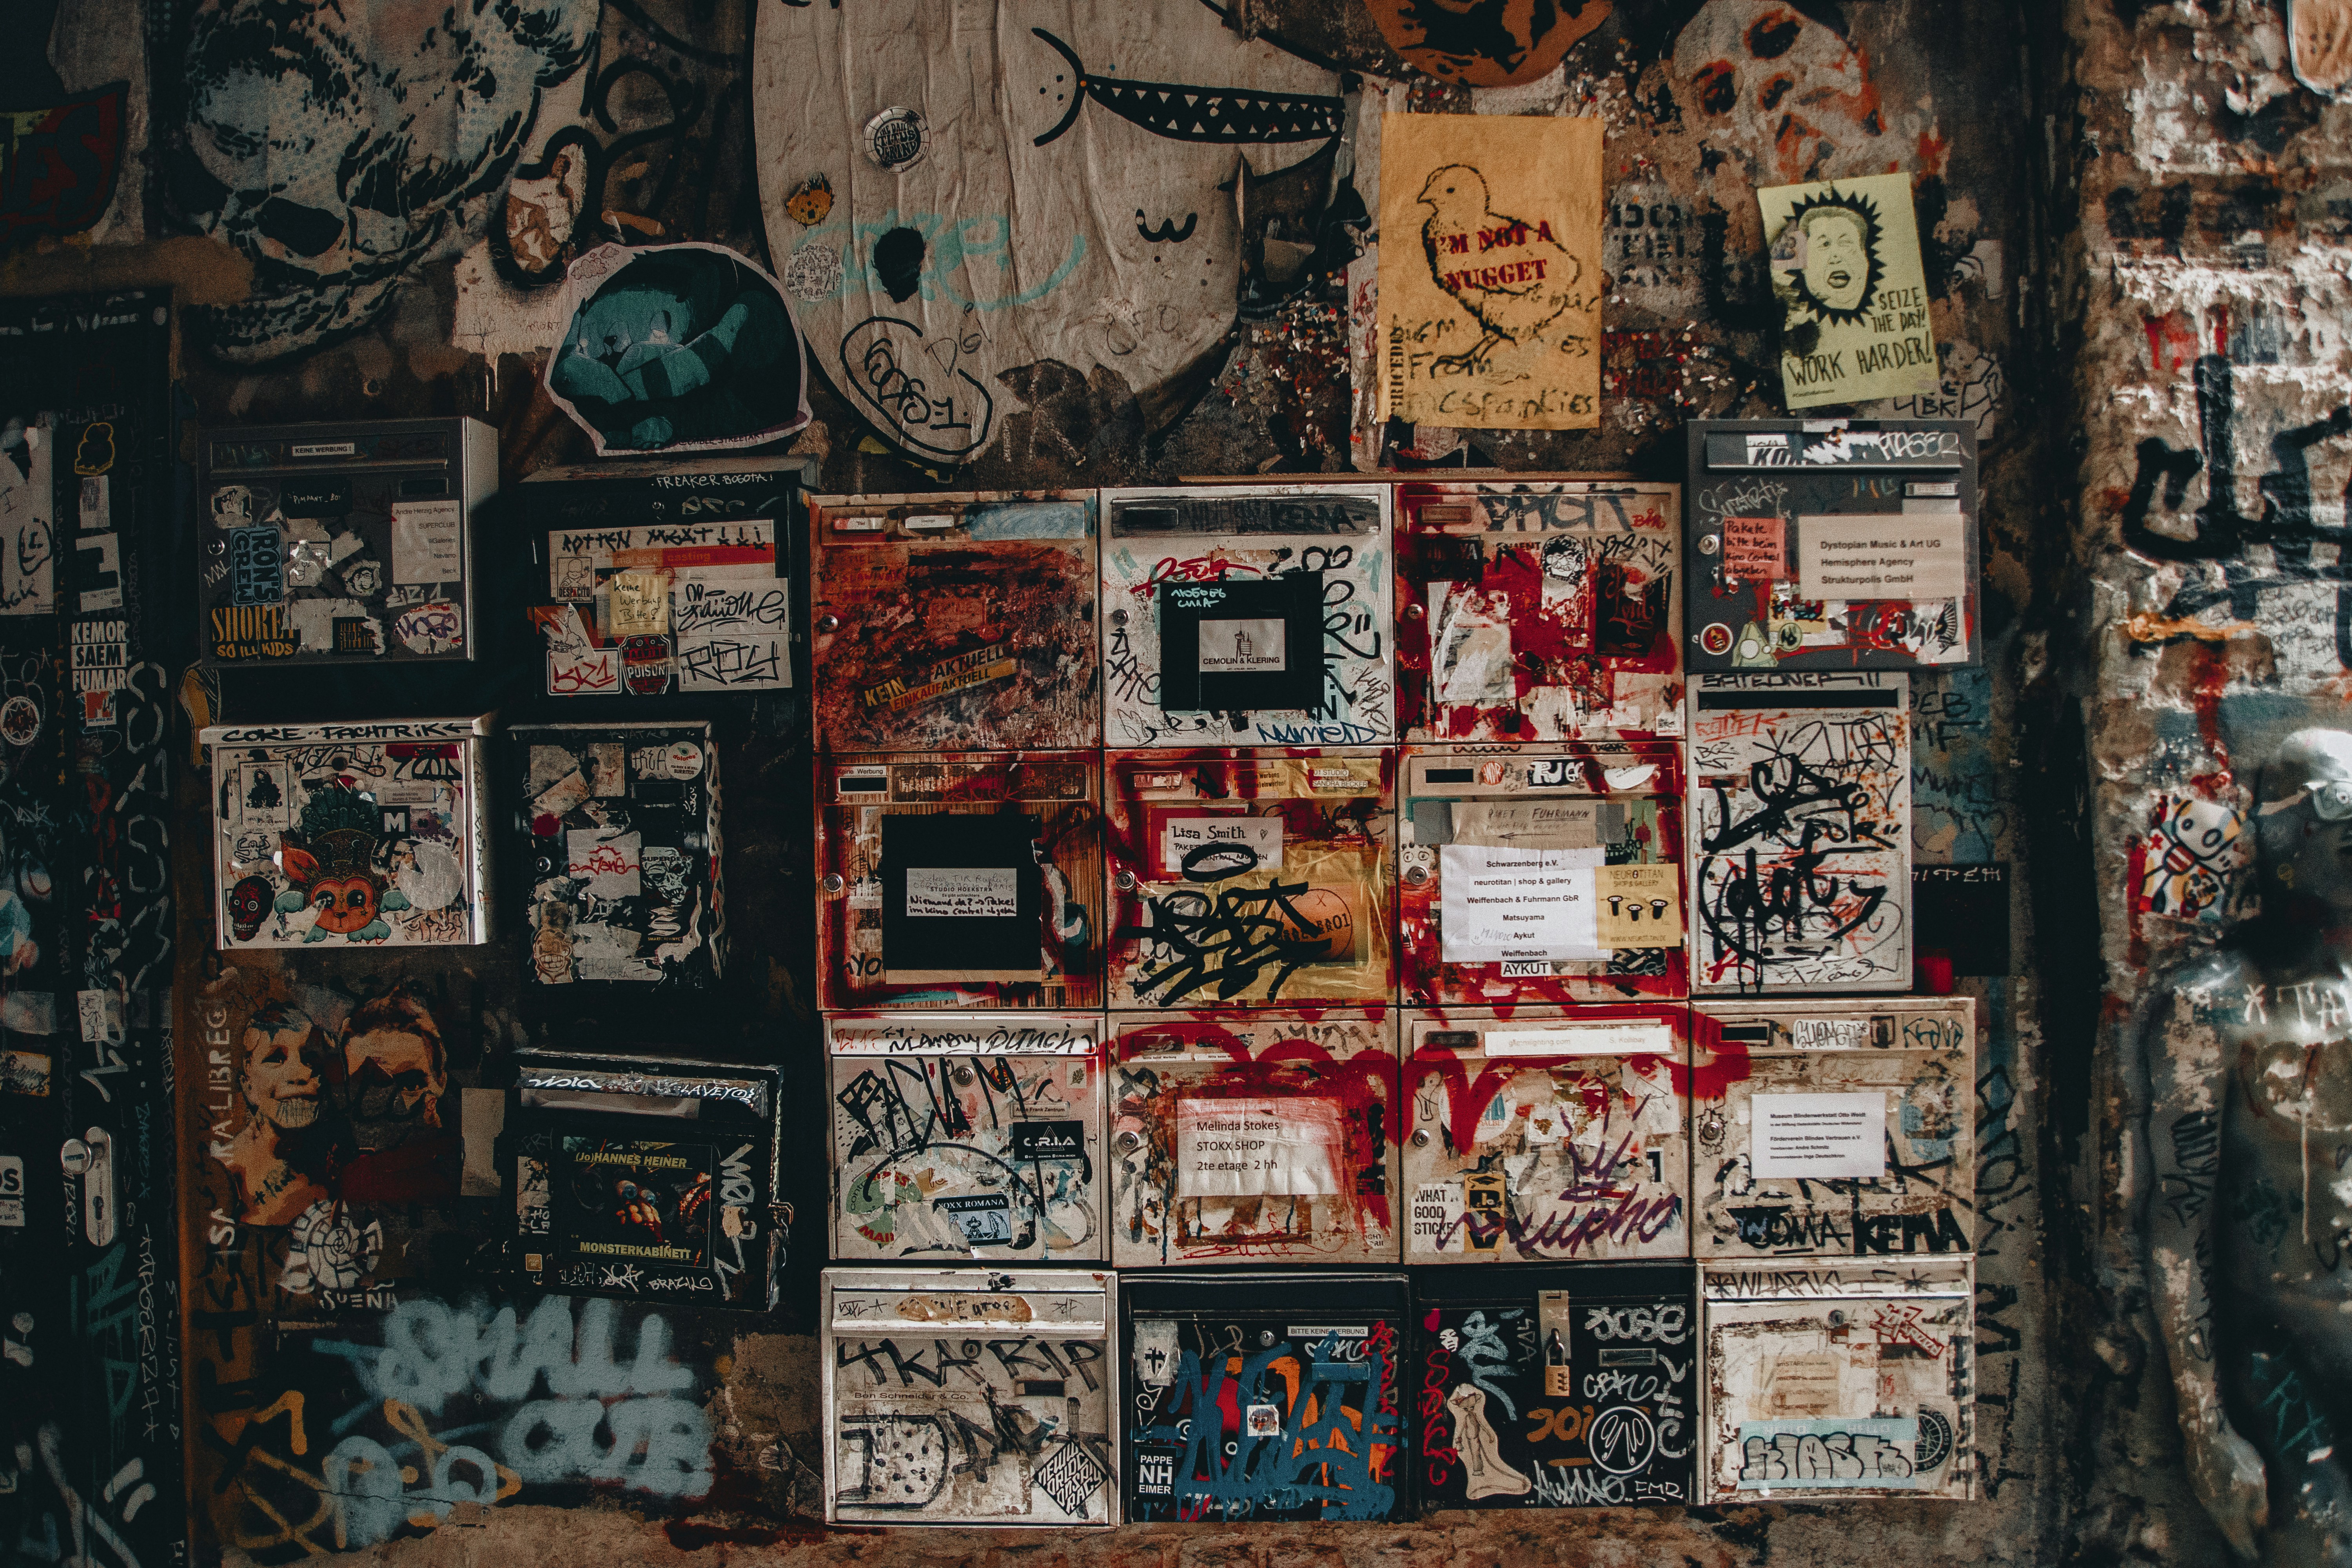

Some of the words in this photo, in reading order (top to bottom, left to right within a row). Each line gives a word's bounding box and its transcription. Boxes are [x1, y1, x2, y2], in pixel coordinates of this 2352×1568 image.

[877, 130, 916, 146] TITUS
[1430, 233, 1470, 255] I'M
[1478, 223, 1526, 252] NOT
[1537, 220, 1554, 243] A
[1446, 259, 1547, 291] NUGGET
[1879, 287, 1922, 310] SEIZE
[1872, 315, 1894, 333] THE
[1901, 307, 1926, 330] DAY!
[1787, 352, 1846, 385] WORK
[1856, 331, 1933, 375] HARDER!
[1821, 541, 1867, 551] Dystopian
[1870, 540, 1897, 548] Music
[1926, 540, 1940, 548] UG
[1821, 558, 1876, 568] Hemisphere
[1880, 558, 1914, 568] Agency
[1821, 575, 1881, 586] Strukturpolis
[1884, 575, 1913, 583] GmbH
[559, 587, 591, 597] DESPACITO
[620, 595, 661, 610] Werbung
[72, 621, 129, 643] KEMOR
[75, 645, 122, 667] SAEM
[217, 644, 236, 657] SO
[240, 646, 258, 657] ILL
[261, 642, 293, 656] KIDS
[934, 645, 1003, 680] AKTUELL
[627, 665, 665, 679] POISON
[73, 669, 126, 691] FUMAR
[865, 677, 906, 706] KEIN
[1171, 826, 1200, 839] Lisa
[1207, 825, 1246, 839] Smith
[910, 895, 953, 906] Niemand
[1503, 964, 1548, 975] AYKUT
[1197, 1120, 1241, 1131] Melinda
[1244, 1120, 1279, 1131] Stokes
[1197, 1141, 1232, 1151] STOKX
[1235, 1140, 1265, 1150] SHOP
[576, 1152, 641, 1166] (Jo)HANNES
[644, 1156, 687, 1169] HEINER
[1197, 1161, 1215, 1171] 2te
[1218, 1161, 1248, 1172] etage
[1254, 1160, 1260, 1170] 2
[1264, 1159, 1278, 1169] hh
[965, 1198, 1005, 1208] ROMANA
[1415, 1191, 1446, 1202] WHAT
[1414, 1207, 1444, 1219] GOOD
[580, 1241, 691, 1259] MONSTERKABINETT
[1140, 1455, 1173, 1465] PAPPE
[1139, 1465, 1172, 1484] NH
[1139, 1485, 1171, 1495] EIMER
